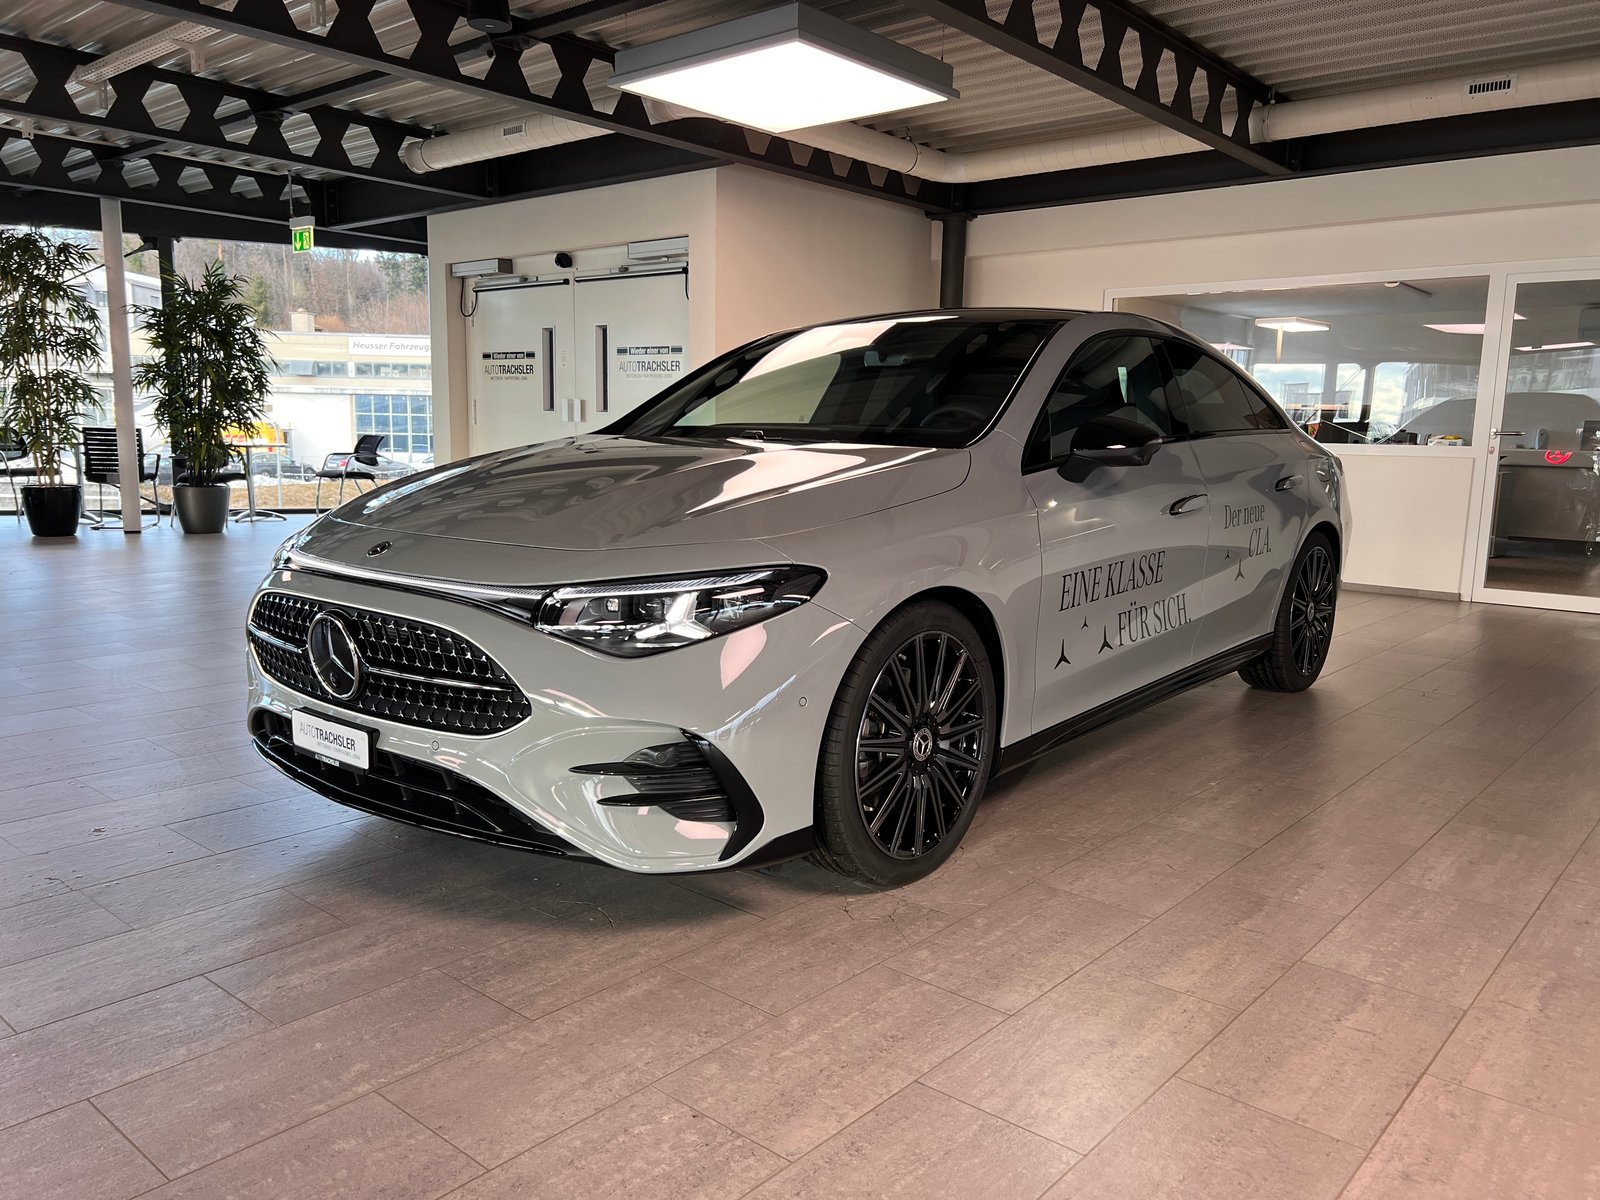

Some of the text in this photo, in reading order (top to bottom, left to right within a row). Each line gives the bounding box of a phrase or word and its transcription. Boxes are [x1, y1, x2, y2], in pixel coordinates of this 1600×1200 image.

[353, 341, 431, 353] Heusser Fahrzeug
[629, 346, 669, 355] Wieder einer von
[484, 364, 534, 375] AUTOTRACHSLER
[618, 360, 681, 372] AUTOTRACHSLER
[1224, 504, 1265, 529] Der neue
[1058, 550, 1166, 612] EINE KLASSE
[1117, 592, 1192, 647] FÜR SICH.
[299, 721, 357, 752] AUTOTRACHSLER
